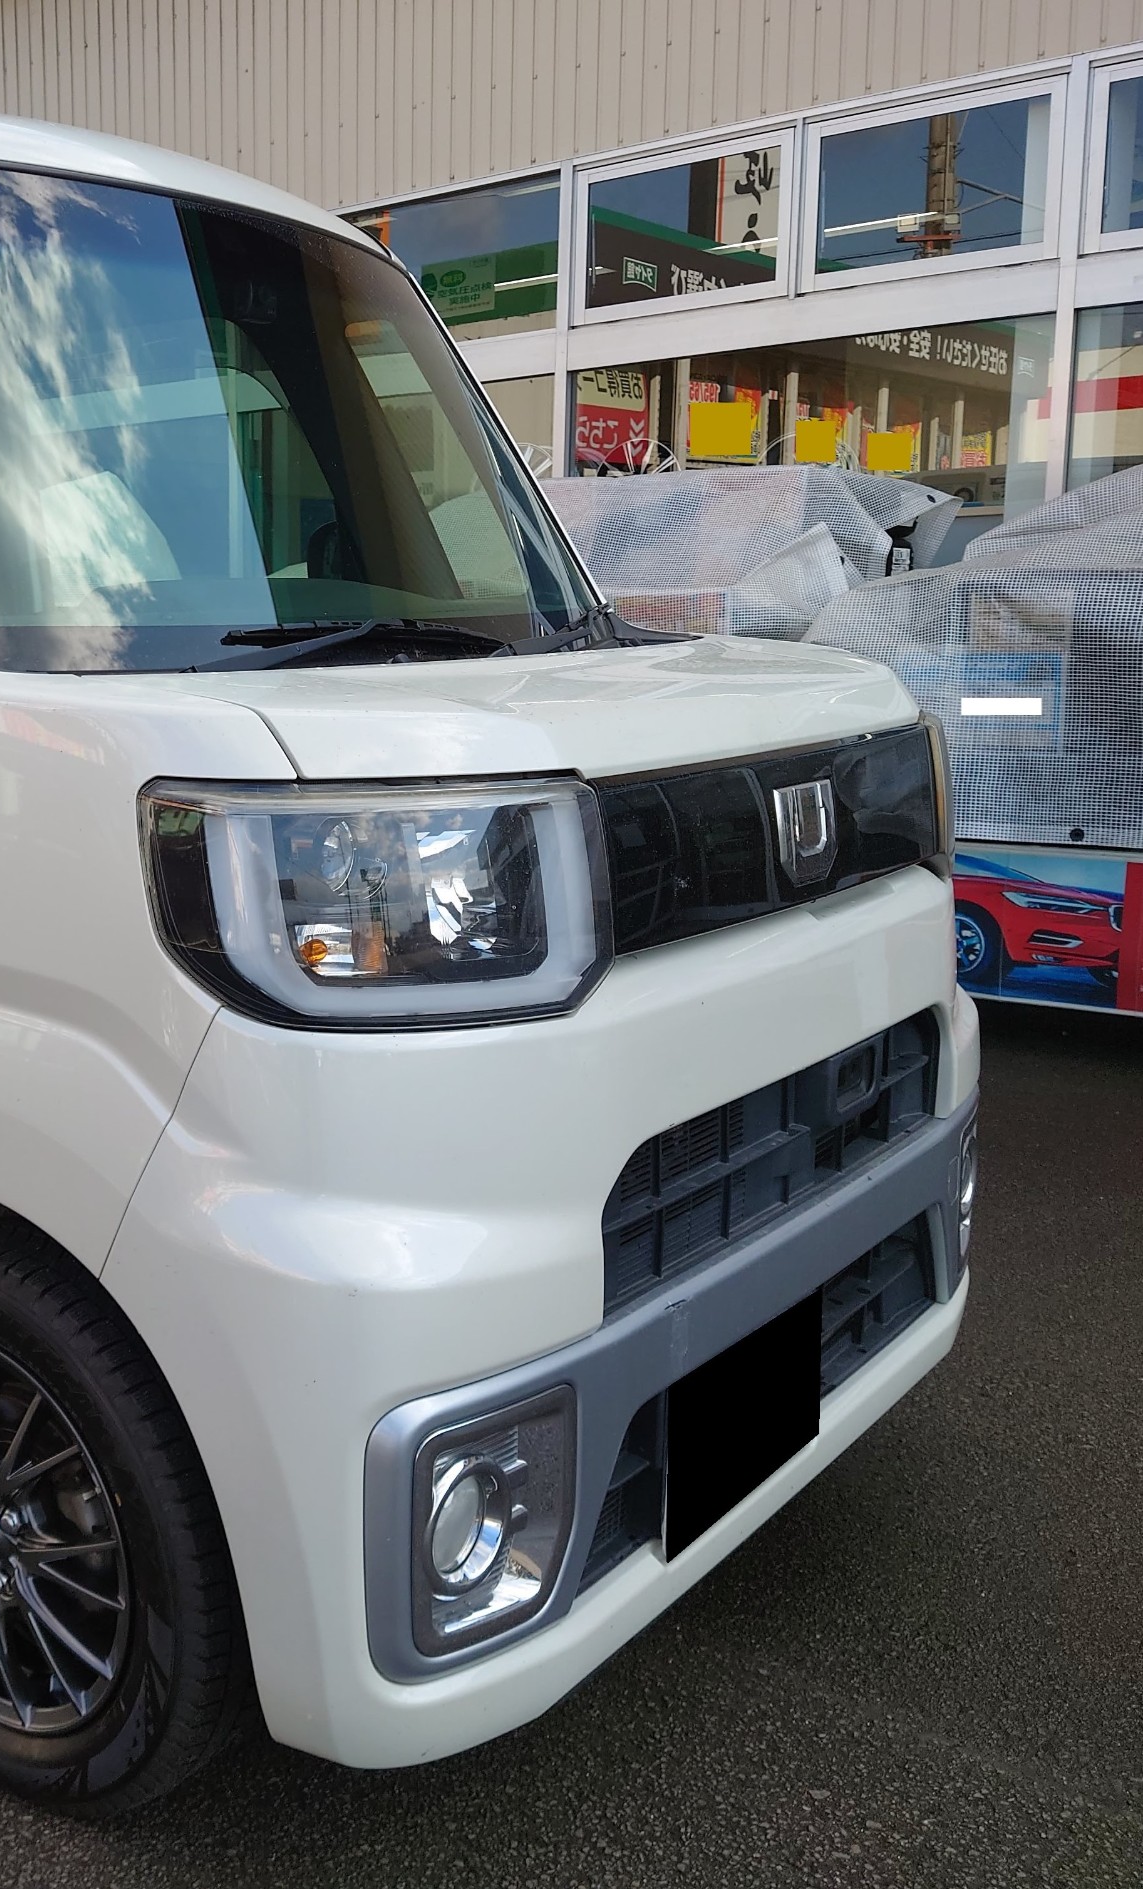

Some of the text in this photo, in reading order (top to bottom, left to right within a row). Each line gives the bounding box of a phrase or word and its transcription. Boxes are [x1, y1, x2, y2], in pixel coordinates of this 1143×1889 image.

[437, 282, 493, 298] 空気圧点検
[449, 294, 481, 305] 実施中
